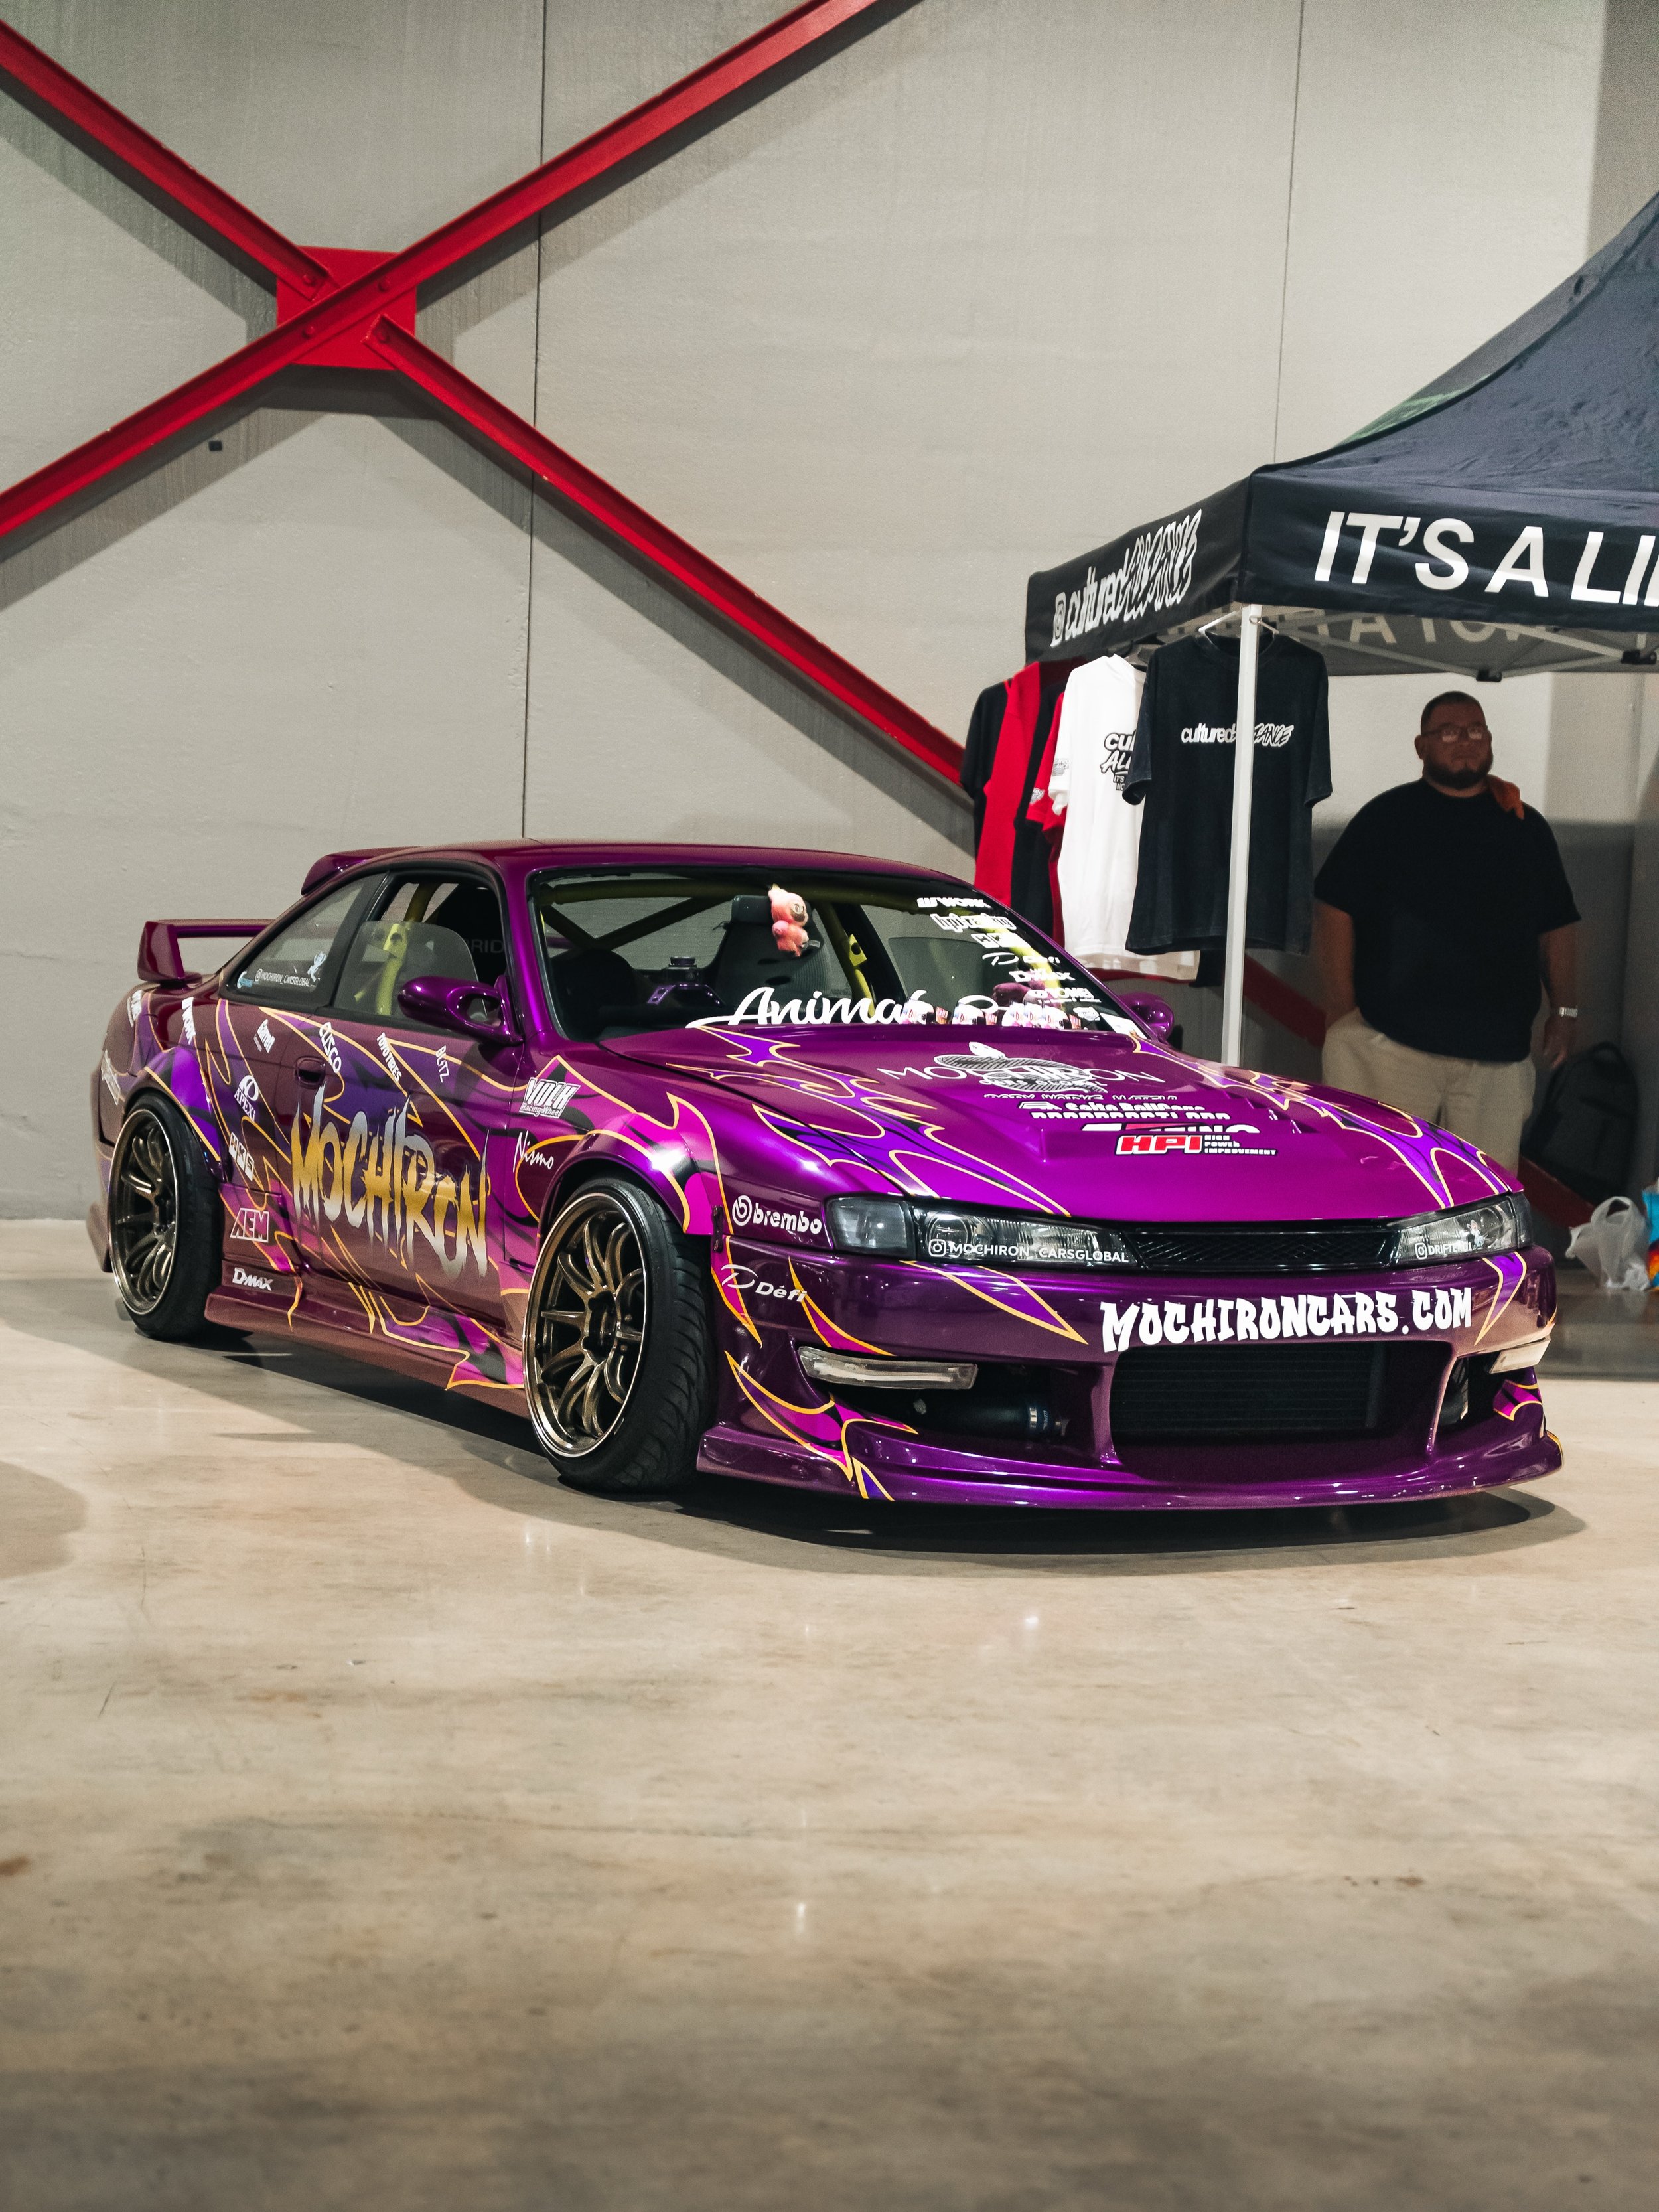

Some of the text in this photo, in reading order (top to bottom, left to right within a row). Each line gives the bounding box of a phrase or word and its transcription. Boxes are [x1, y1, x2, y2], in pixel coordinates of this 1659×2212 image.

[1315, 511, 1474, 591] IT'S
[1485, 526, 1549, 597] A
[465, 938, 504, 954] RID
[319, 1022, 342, 1074] CUSCO
[376, 1032, 402, 1082] TOYO TIRES
[435, 1045, 450, 1083] BLITZ
[520, 1102, 563, 1118] Racing Wheel
[228, 1131, 255, 1181] HKS
[1115, 1134, 1204, 1156] HPI
[230, 1207, 269, 1243] AEM
[753, 1203, 822, 1235] brembo
[1100, 1286, 1472, 1353] MOCHIRONCARS.COM
